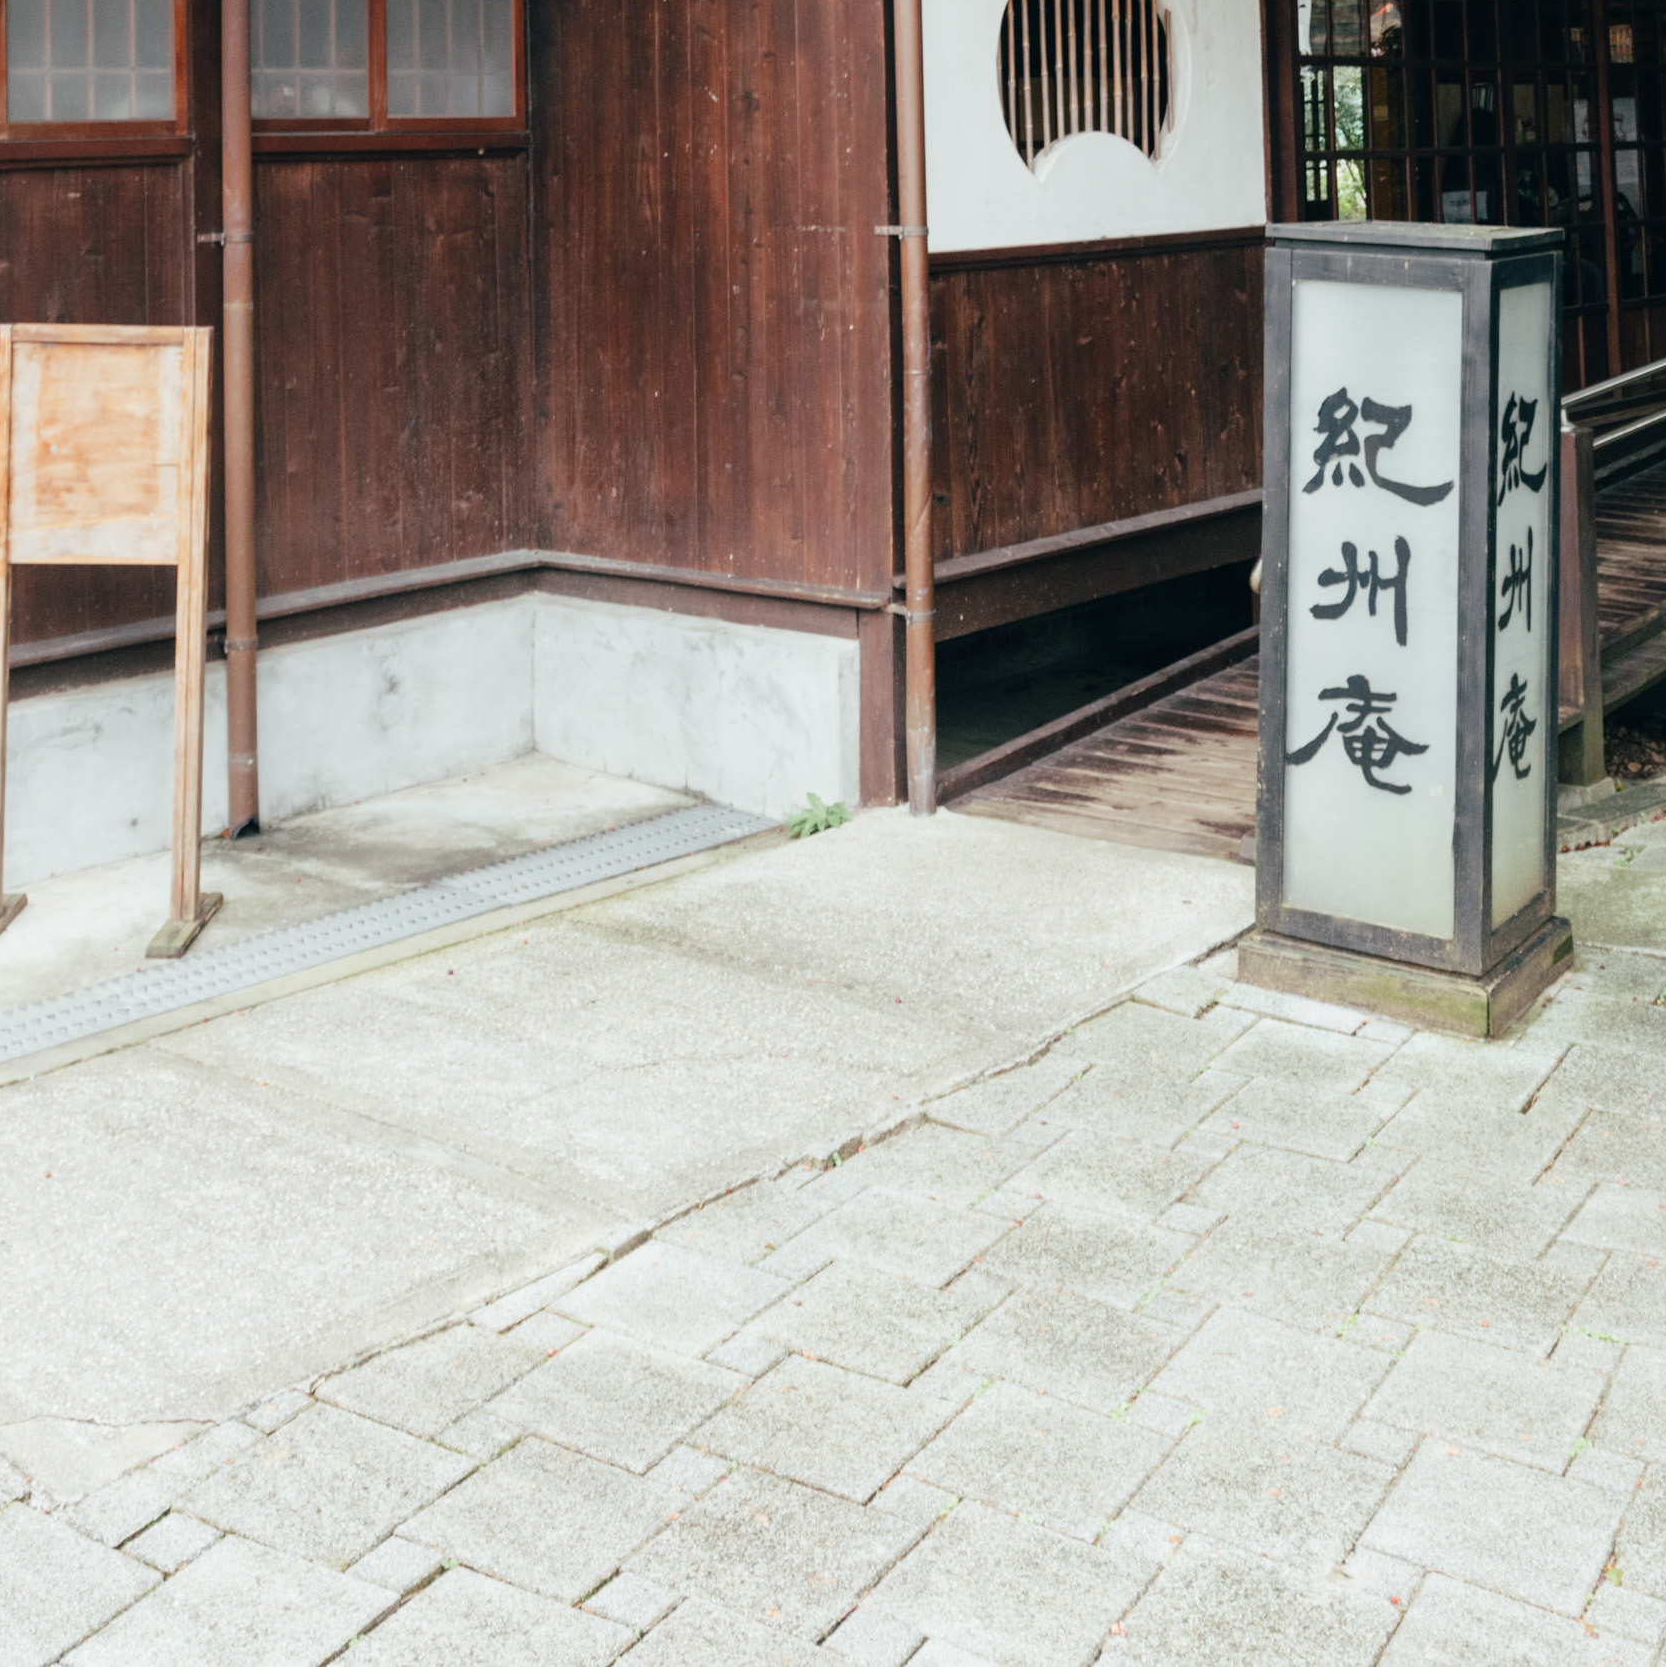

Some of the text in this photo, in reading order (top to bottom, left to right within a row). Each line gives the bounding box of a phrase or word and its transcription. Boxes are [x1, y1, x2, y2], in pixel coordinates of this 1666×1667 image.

[1288, 387, 1454, 795] 紀州庵
[1493, 391, 1547, 780] 紀州庵
